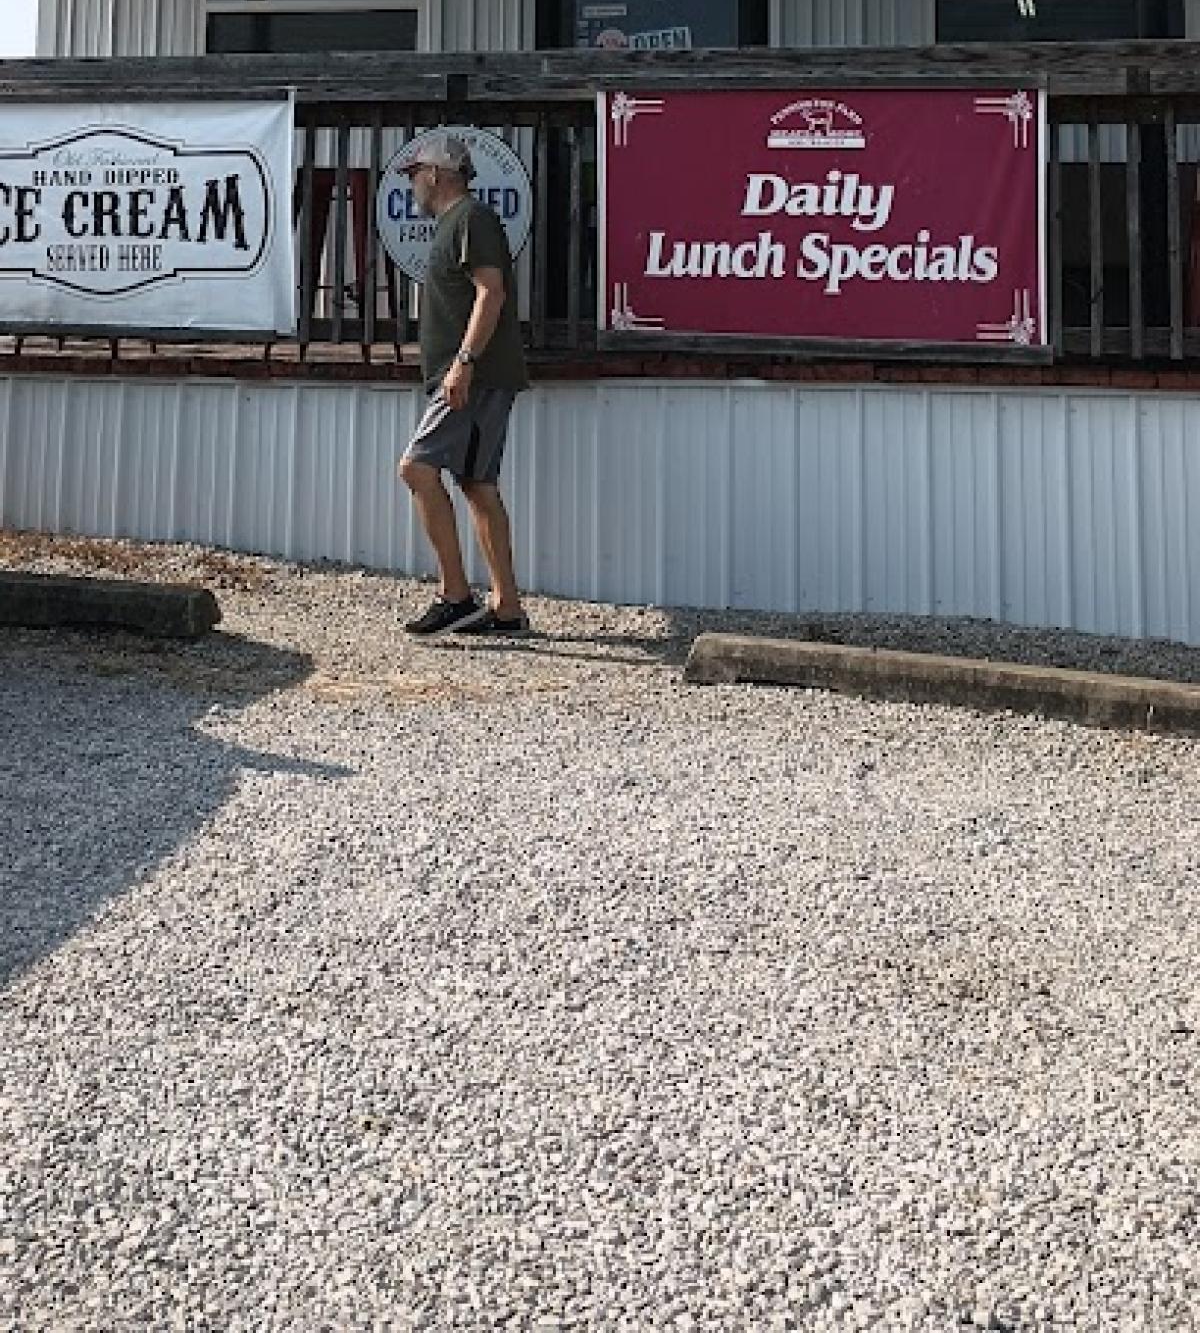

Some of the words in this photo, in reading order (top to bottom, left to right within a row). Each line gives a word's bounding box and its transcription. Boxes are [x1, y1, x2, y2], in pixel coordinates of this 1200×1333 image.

[634, 29, 686, 49] OPEN
[33, 170, 92, 186] HAND
[104, 168, 180, 185] DIPPED
[62, 173, 250, 251] CREAM
[741, 170, 895, 231] Daily
[47, 244, 109, 272] SERVED
[117, 244, 163, 272] HERE
[644, 230, 785, 279] Lunch
[797, 229, 998, 295] Specials
